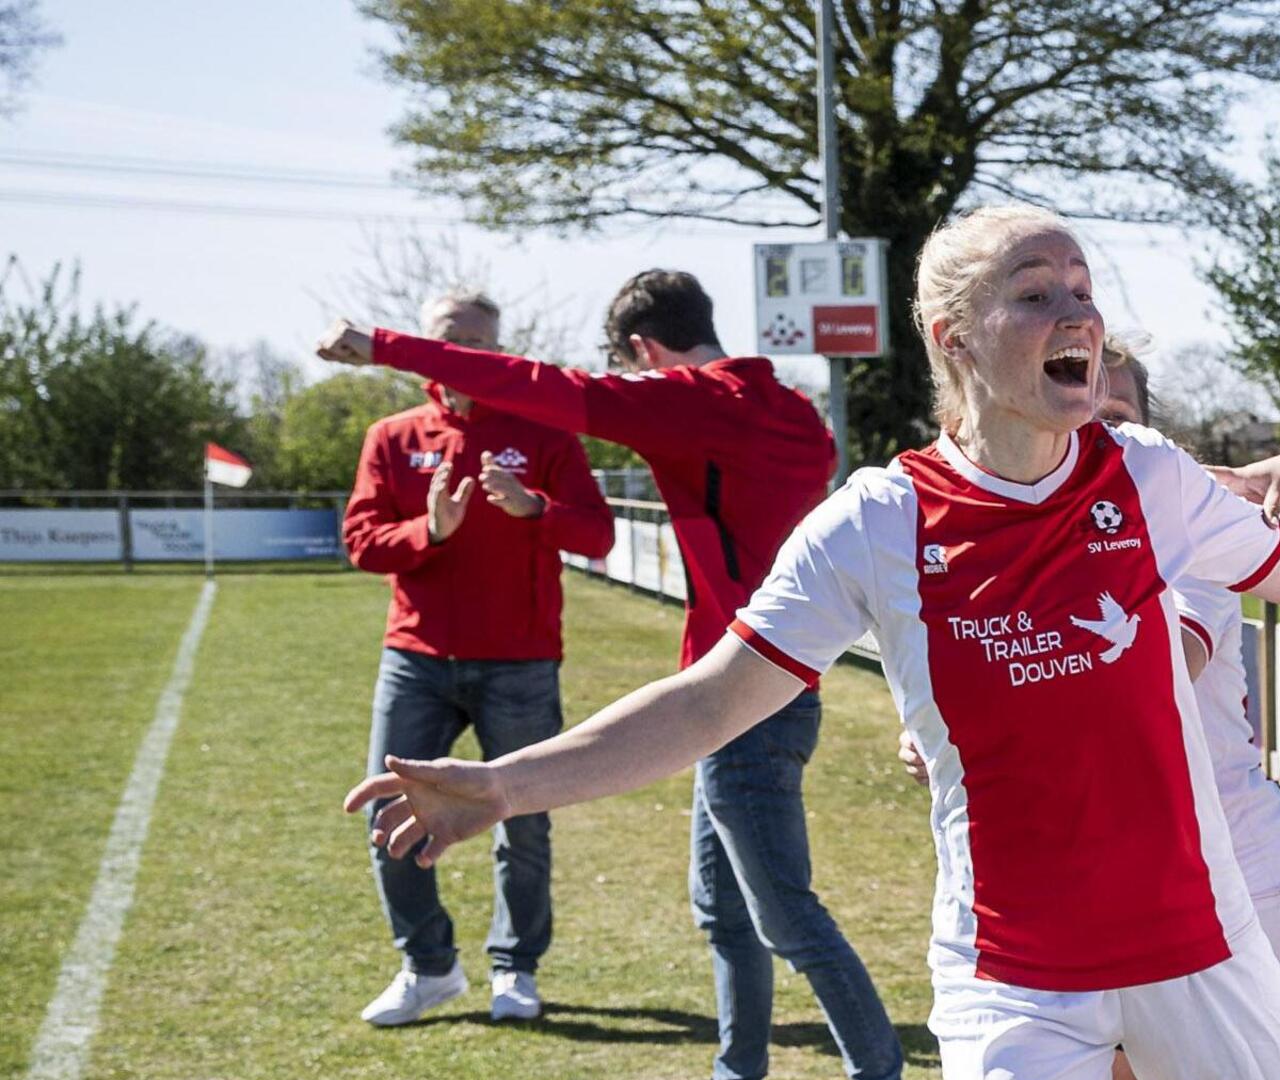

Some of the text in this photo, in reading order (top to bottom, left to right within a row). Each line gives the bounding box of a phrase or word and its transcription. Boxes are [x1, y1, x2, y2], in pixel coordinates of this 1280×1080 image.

[1088, 538, 1141, 553] SV Leveroy
[948, 610, 1034, 640] TRUCK &
[980, 631, 1063, 662] TRAILER
[1009, 651, 1093, 687] DOUVEN
